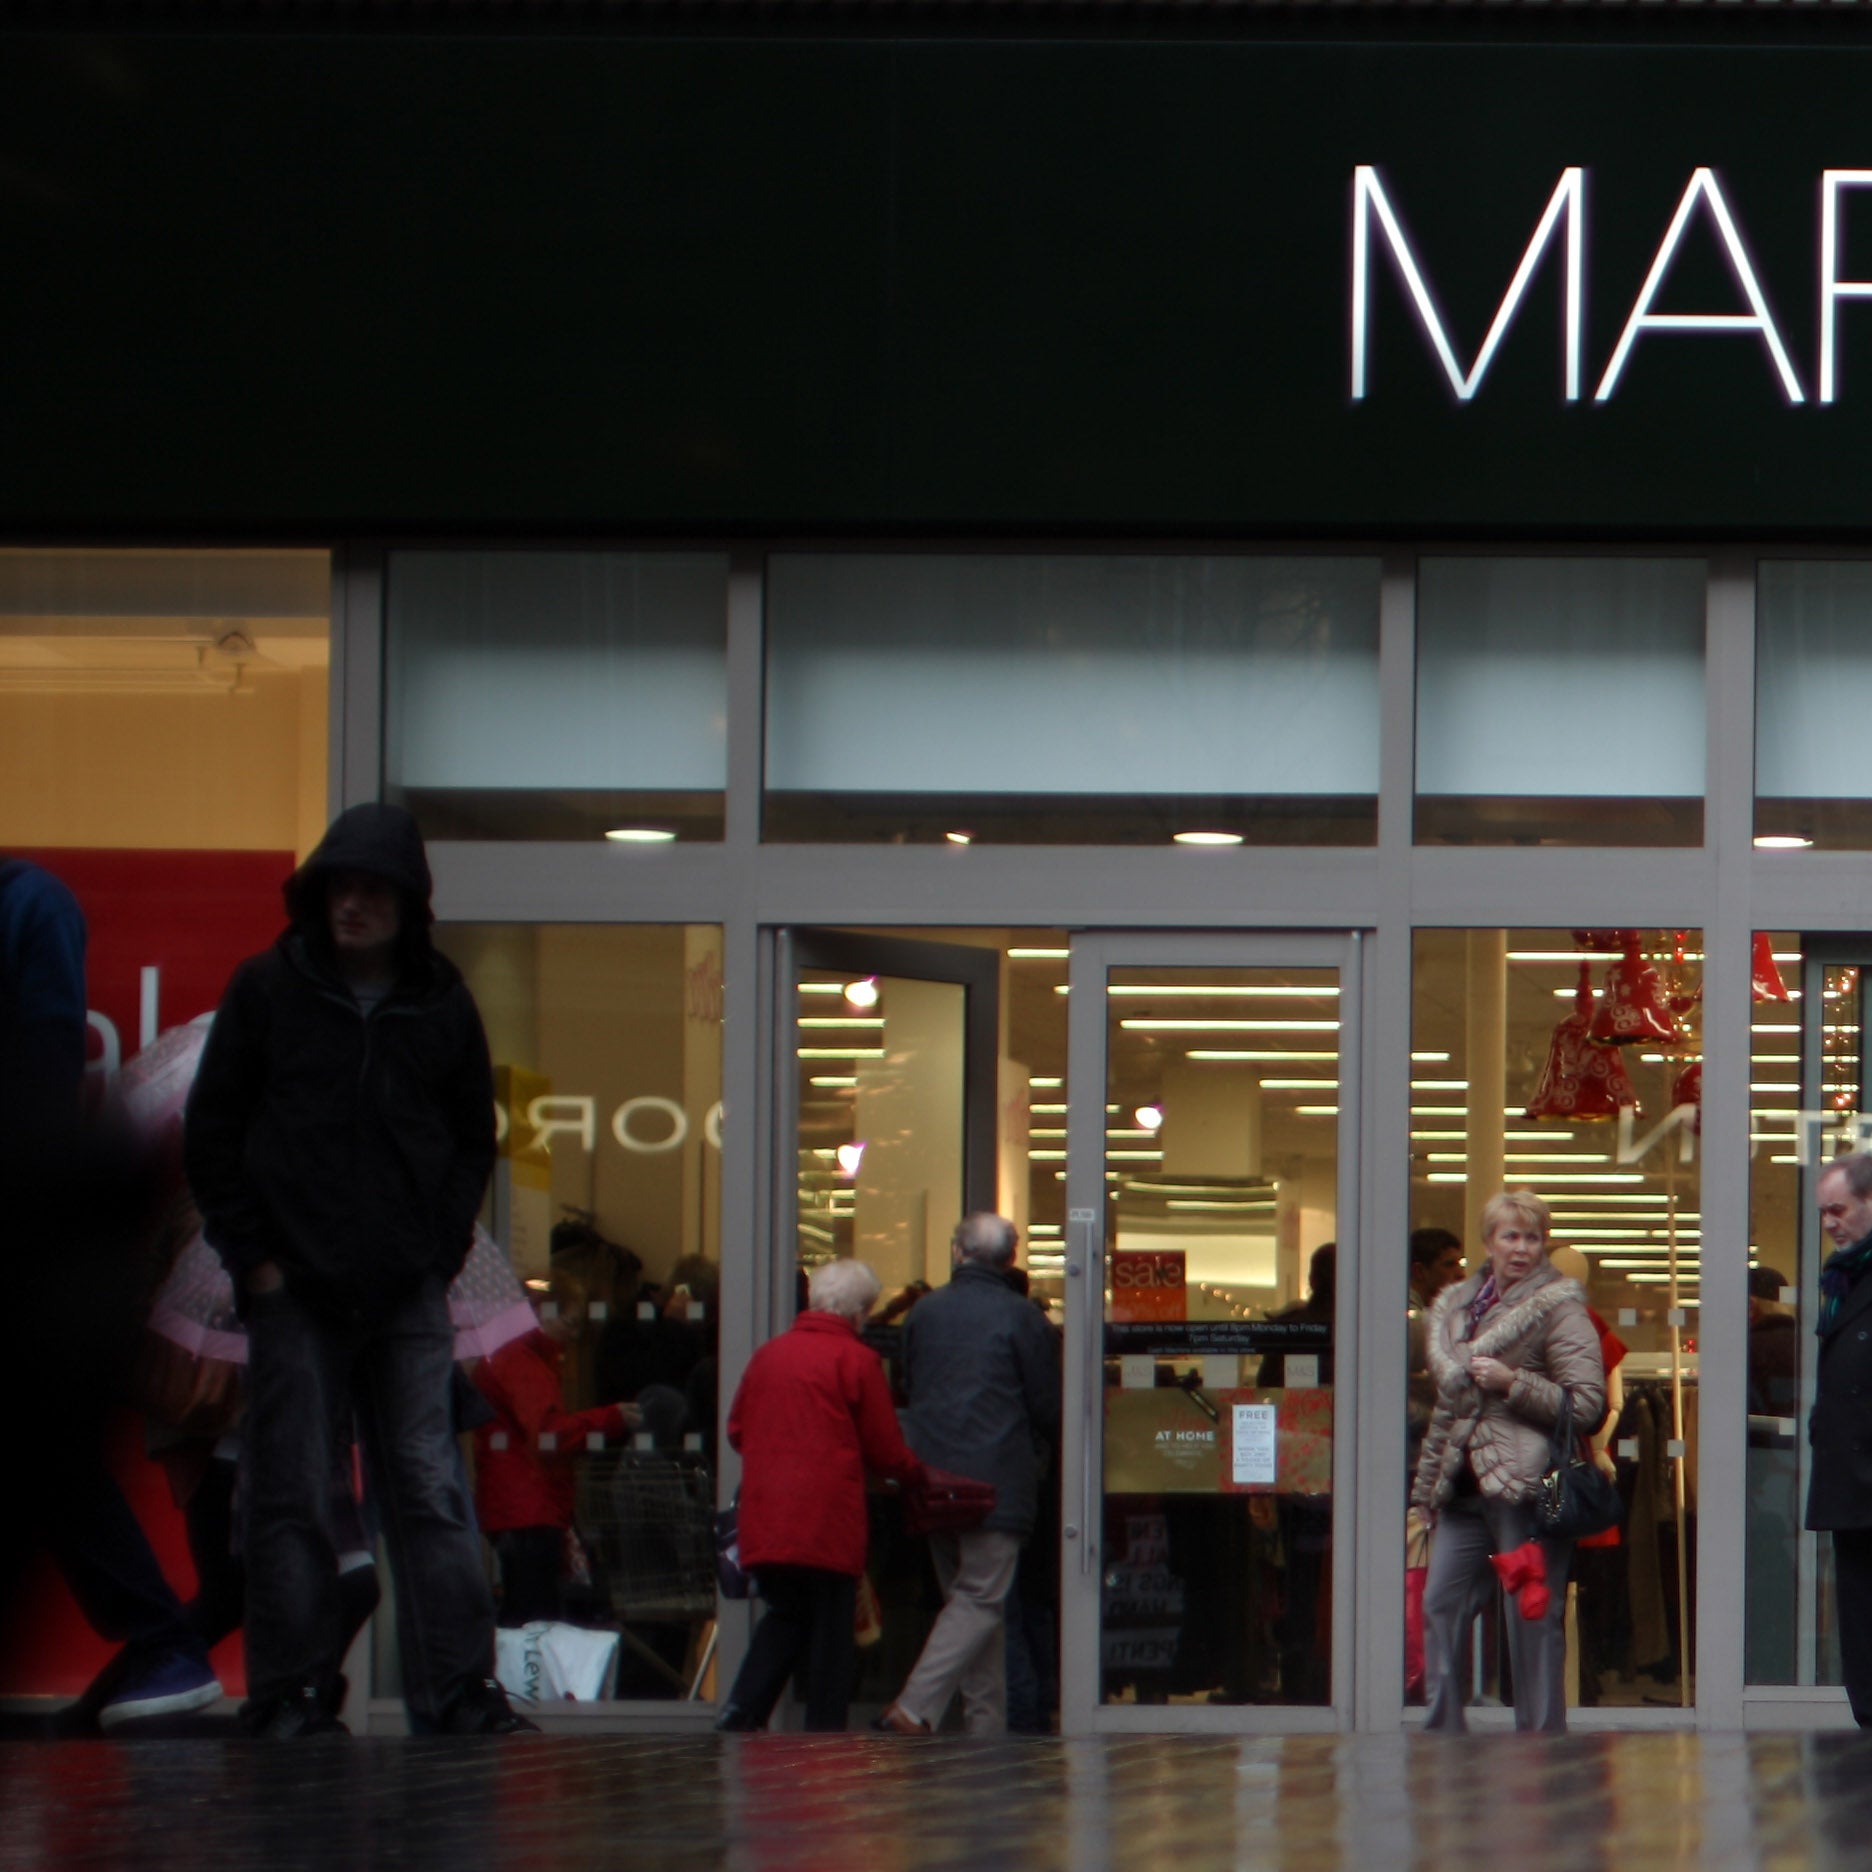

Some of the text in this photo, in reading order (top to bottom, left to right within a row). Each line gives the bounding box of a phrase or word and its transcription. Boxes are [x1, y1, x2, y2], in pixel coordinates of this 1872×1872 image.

[1115, 1256, 1181, 1288] sale
[1238, 1410, 1269, 1420] FREE
[1155, 1430, 1216, 1441] AT HOME
[524, 1650, 541, 1700] Lew
